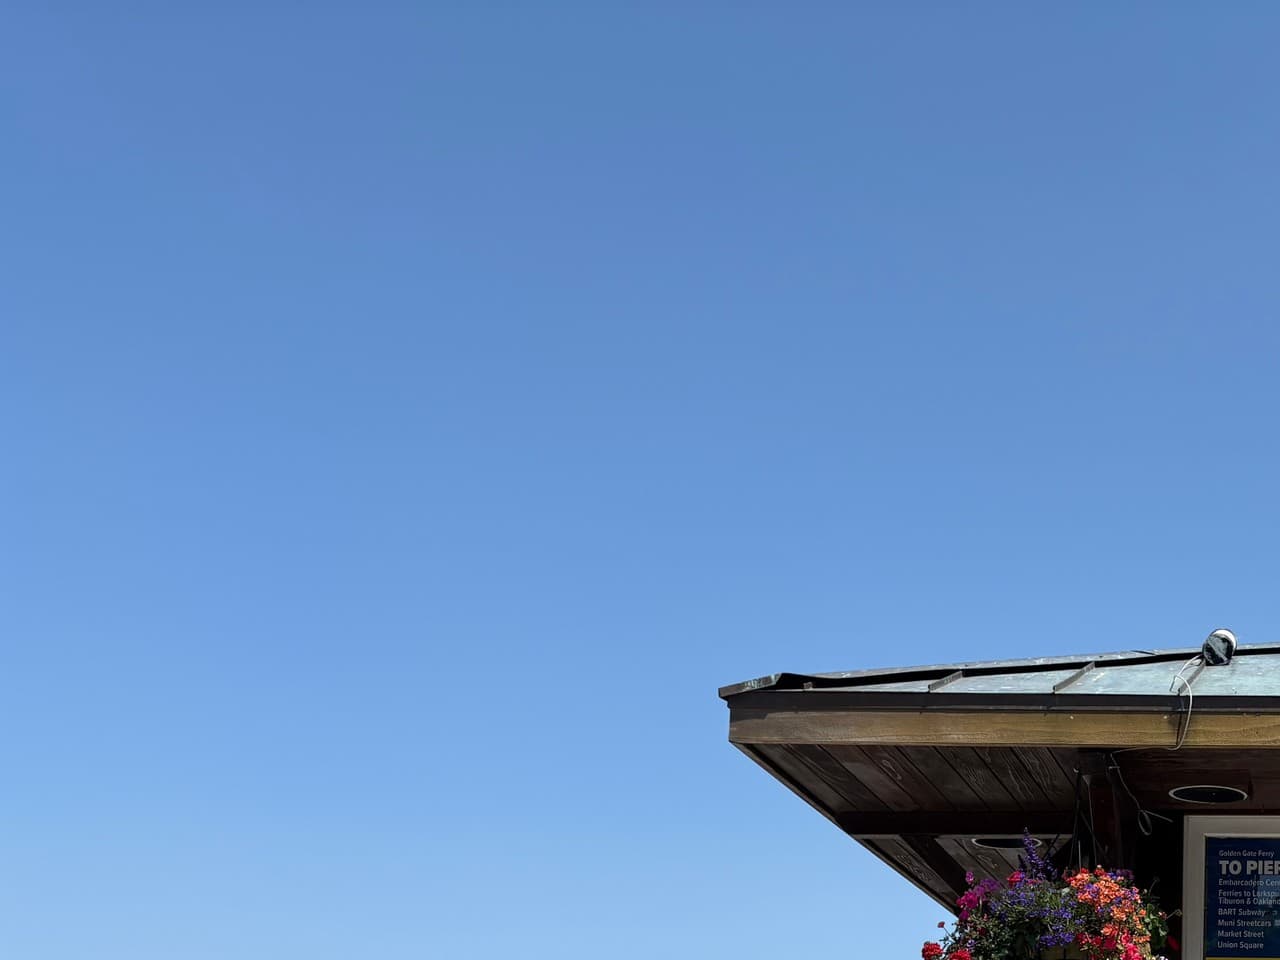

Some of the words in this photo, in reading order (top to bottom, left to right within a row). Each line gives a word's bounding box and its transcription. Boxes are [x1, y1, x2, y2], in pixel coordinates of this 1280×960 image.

[1258, 850, 1275, 858] Ferry
[1218, 860, 1242, 875] TO
[1218, 879, 1264, 887] Embarcadero
[1218, 889, 1242, 897] Ferries
[1218, 897, 1245, 905] Tiburon
[1246, 897, 1251, 905] &
[1238, 908, 1266, 917] Subway
[1217, 919, 1236, 927] Muni
[1237, 919, 1272, 927] Streetcars
[1217, 930, 1242, 938] Market
[1243, 930, 1264, 938] Street
[1239, 941, 1264, 950] Square
